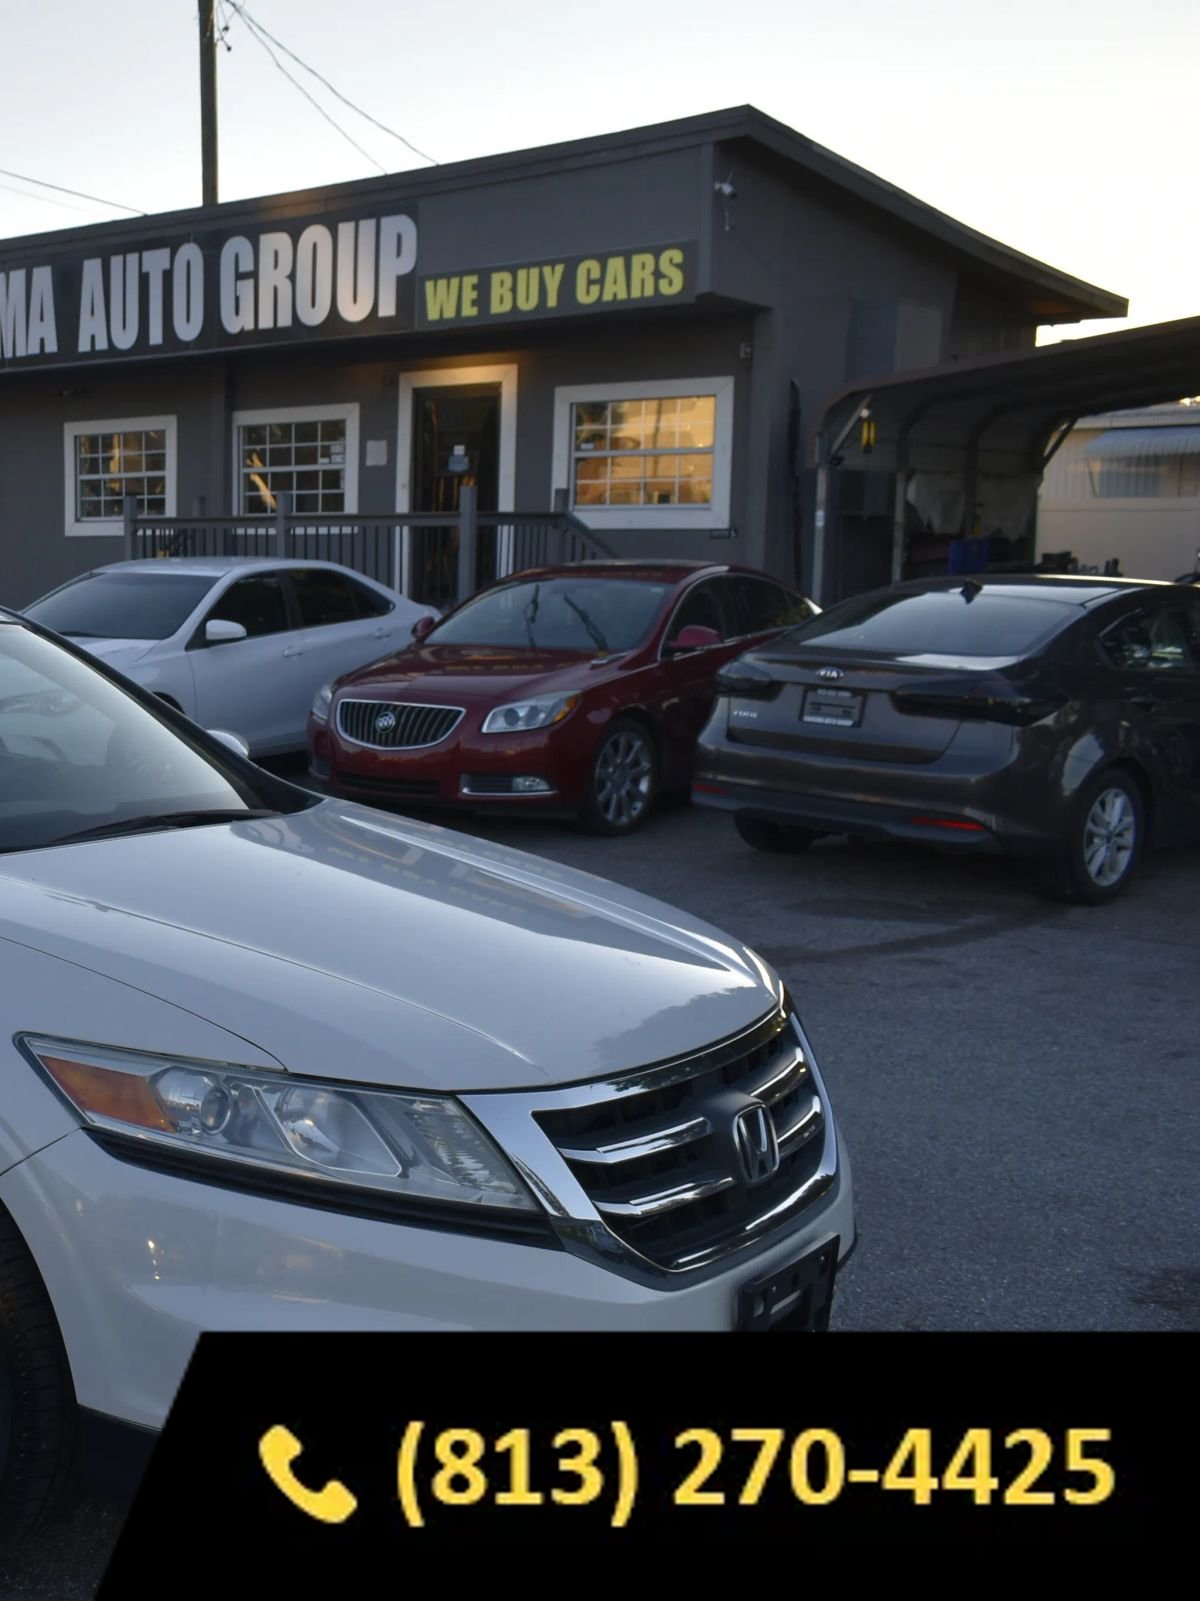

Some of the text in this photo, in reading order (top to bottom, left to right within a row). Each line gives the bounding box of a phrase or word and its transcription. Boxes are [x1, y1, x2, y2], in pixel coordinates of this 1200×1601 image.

[78, 242, 204, 352] AUTO
[220, 214, 417, 335] GROUP
[425, 249, 684, 321] WE BUY CARS
